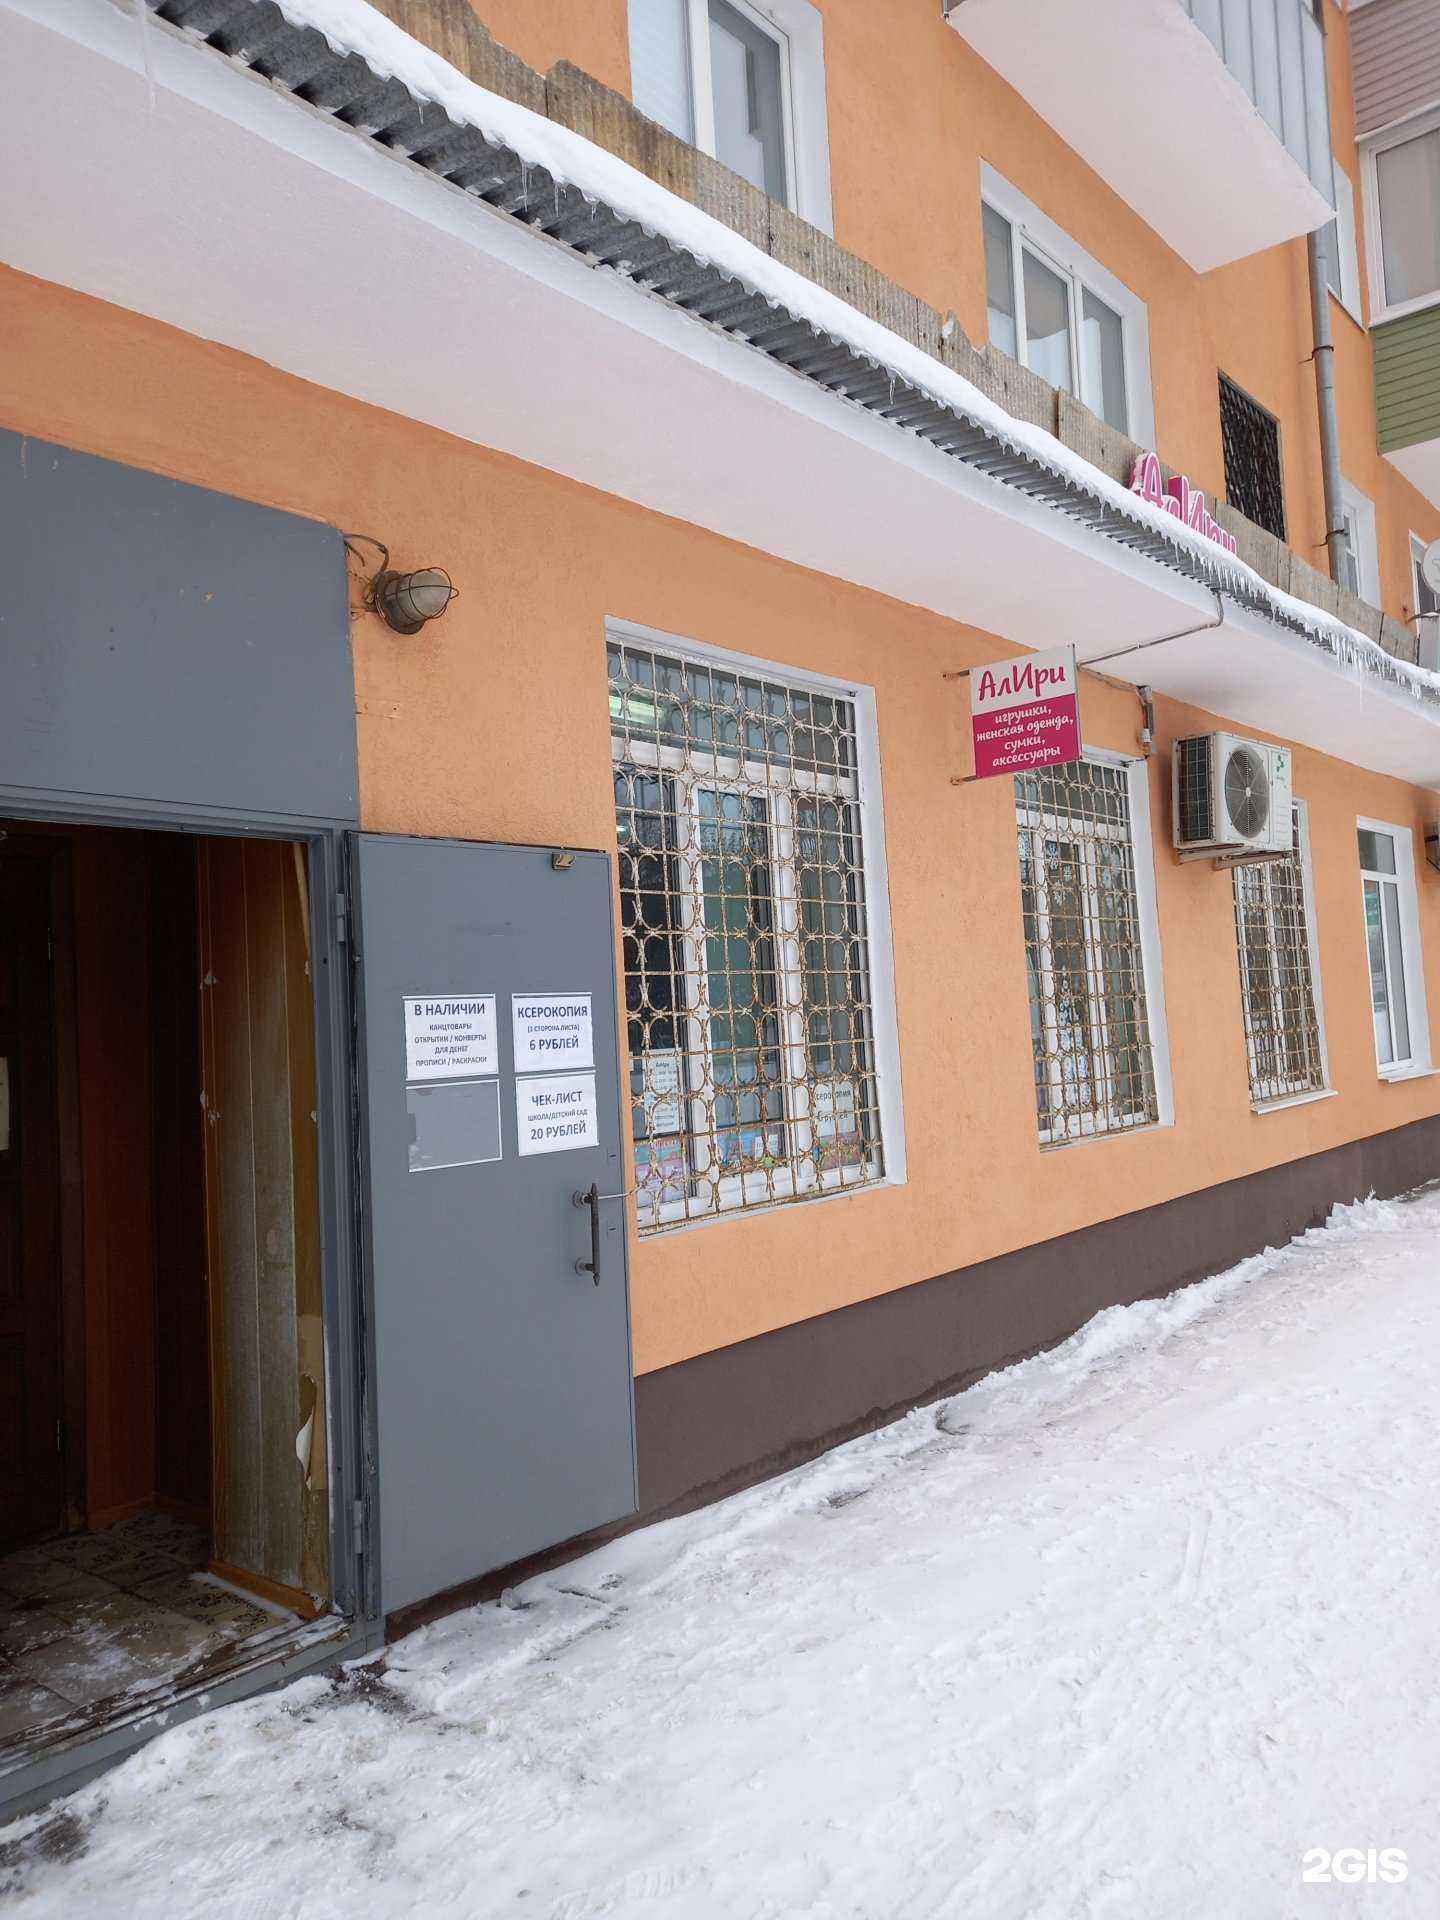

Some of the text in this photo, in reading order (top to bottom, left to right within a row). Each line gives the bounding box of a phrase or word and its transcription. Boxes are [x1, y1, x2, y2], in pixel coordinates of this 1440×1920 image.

[978, 662, 1066, 701] АлИри
[995, 705, 1052, 725] игрушки,
[976, 714, 1074, 742] женская одежда,
[1004, 736, 1046, 753] сумки,
[992, 746, 1061, 767] аксессуары
[414, 1003, 486, 1016] В НАЛИЧИИ
[517, 1006, 588, 1018] КСЕРОКОПИЯ
[429, 1023, 473, 1032] КАНЦТОВАРЫ
[454, 1034, 487, 1042] КОНВЕРТЫ
[529, 1034, 579, 1050] 6 РУБЛЕЙ
[434, 1046, 449, 1054] ДЛЯ
[415, 1058, 447, 1067] ПРОПИСИ
[451, 1056, 487, 1065] РАСКРАСКИ
[531, 1091, 583, 1107] ЧЕК-ЛИСТ
[530, 1120, 586, 1140] 20 РУБЛЕЙ
